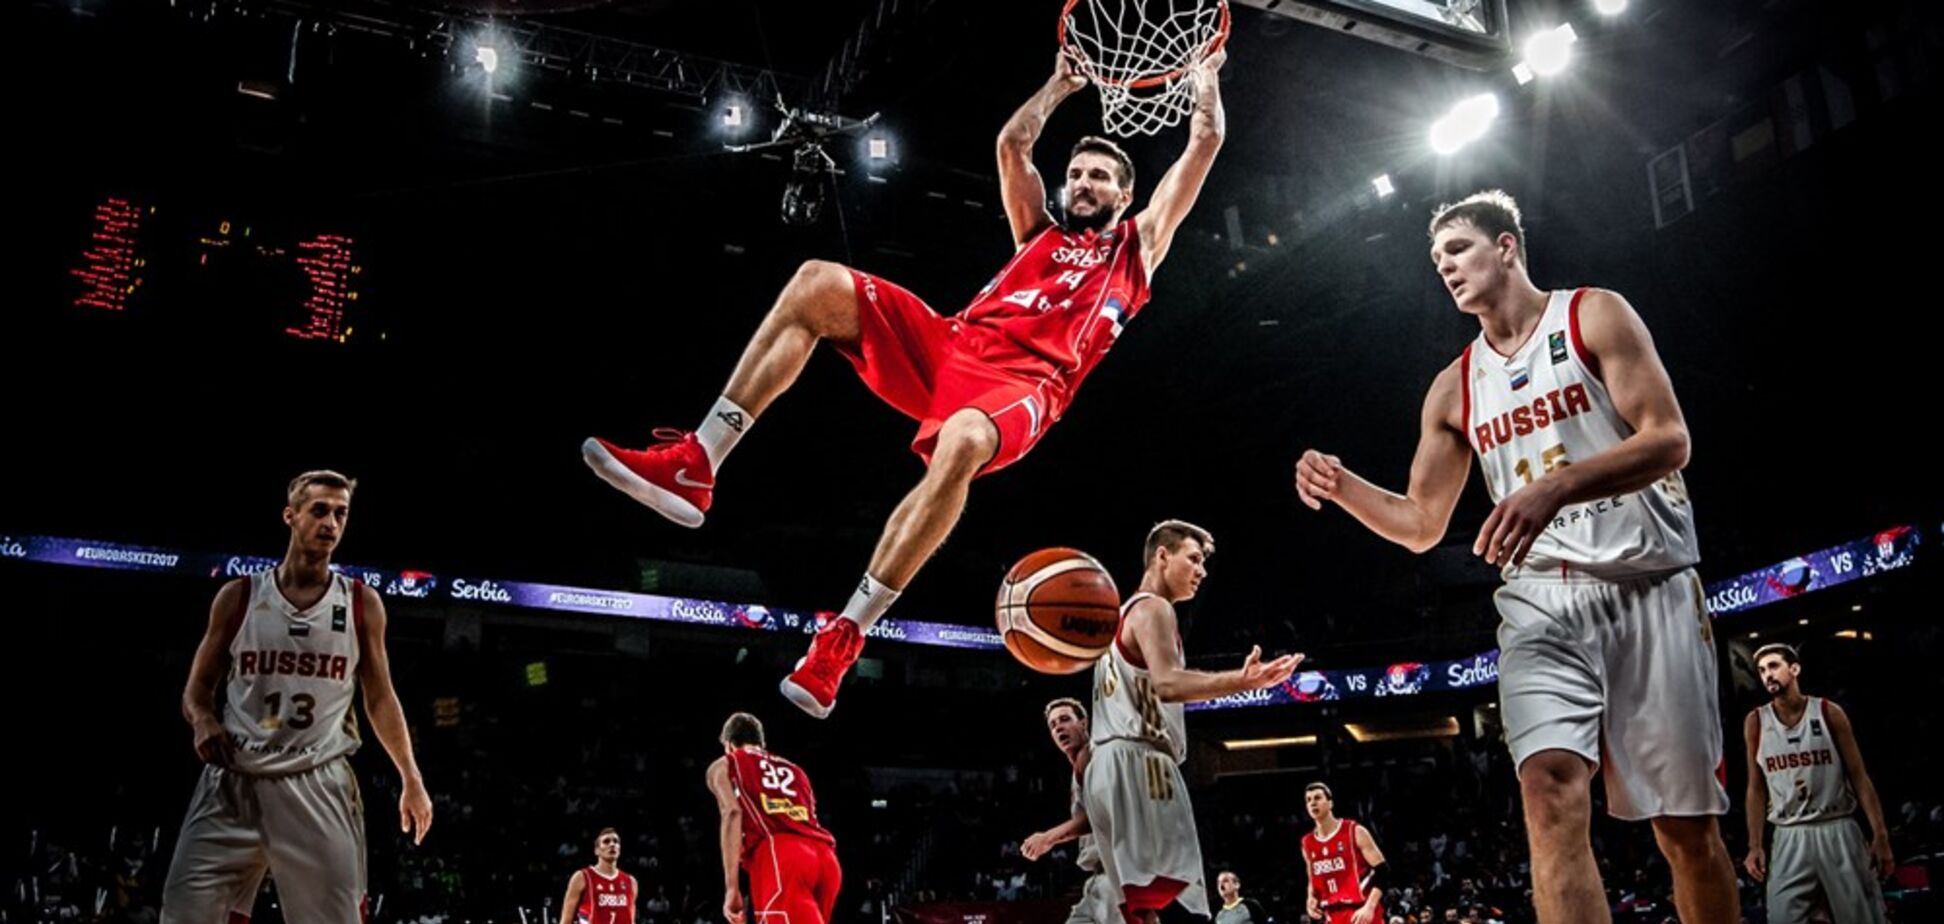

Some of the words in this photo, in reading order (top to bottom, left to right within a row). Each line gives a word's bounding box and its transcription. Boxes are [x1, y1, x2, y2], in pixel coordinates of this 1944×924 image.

[1056, 270, 1087, 290] 14
[1475, 382, 1591, 454] RUSSIA
[1550, 494, 1624, 529] RFACE
[363, 572, 382, 587] VS
[451, 578, 512, 603] Serbia
[1706, 582, 1758, 613] ussia
[1830, 552, 1854, 574] VS
[672, 600, 726, 622] Russia
[783, 613, 800, 627] VS
[867, 619, 907, 640] erbia
[241, 650, 348, 680] RUSSIA
[1346, 675, 1367, 691] VS
[1448, 656, 1499, 687] Serbia
[261, 691, 316, 730] 13
[1766, 749, 1832, 772] RUSSIA
[760, 760, 797, 797] 32
